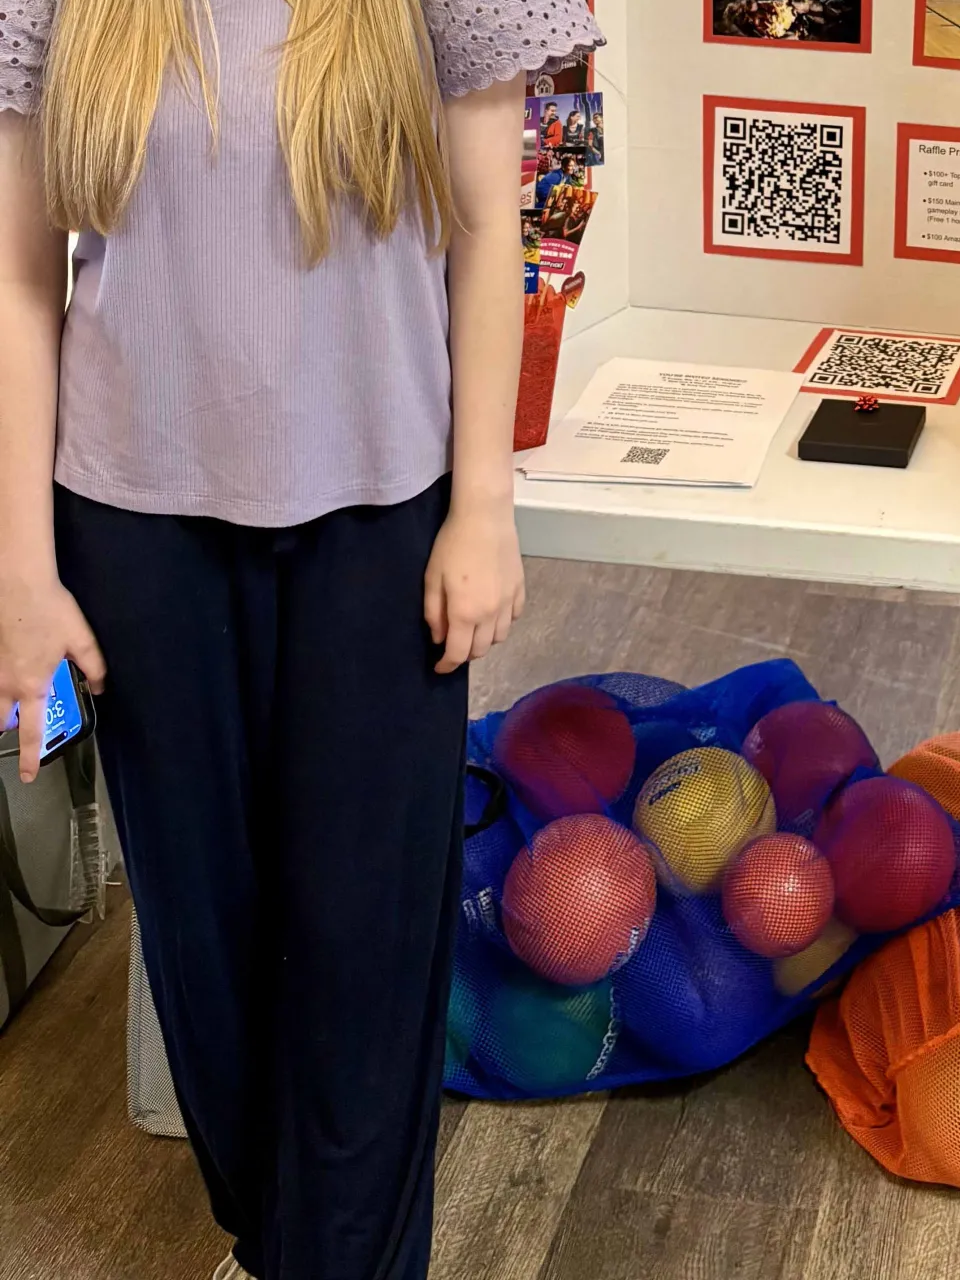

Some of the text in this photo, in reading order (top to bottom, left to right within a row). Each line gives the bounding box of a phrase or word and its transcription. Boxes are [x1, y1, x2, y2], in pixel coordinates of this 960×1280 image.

[918, 144, 946, 155] Raffle
[928, 170, 948, 178] $100+
[927, 179, 938, 187] gift
[927, 197, 944, 205] $150
[944, 198, 960, 206] Main
[926, 207, 958, 216] gameplay
[926, 215, 945, 223] (Free
[926, 232, 943, 241] $100
[45, 700, 65, 725] 3:0
